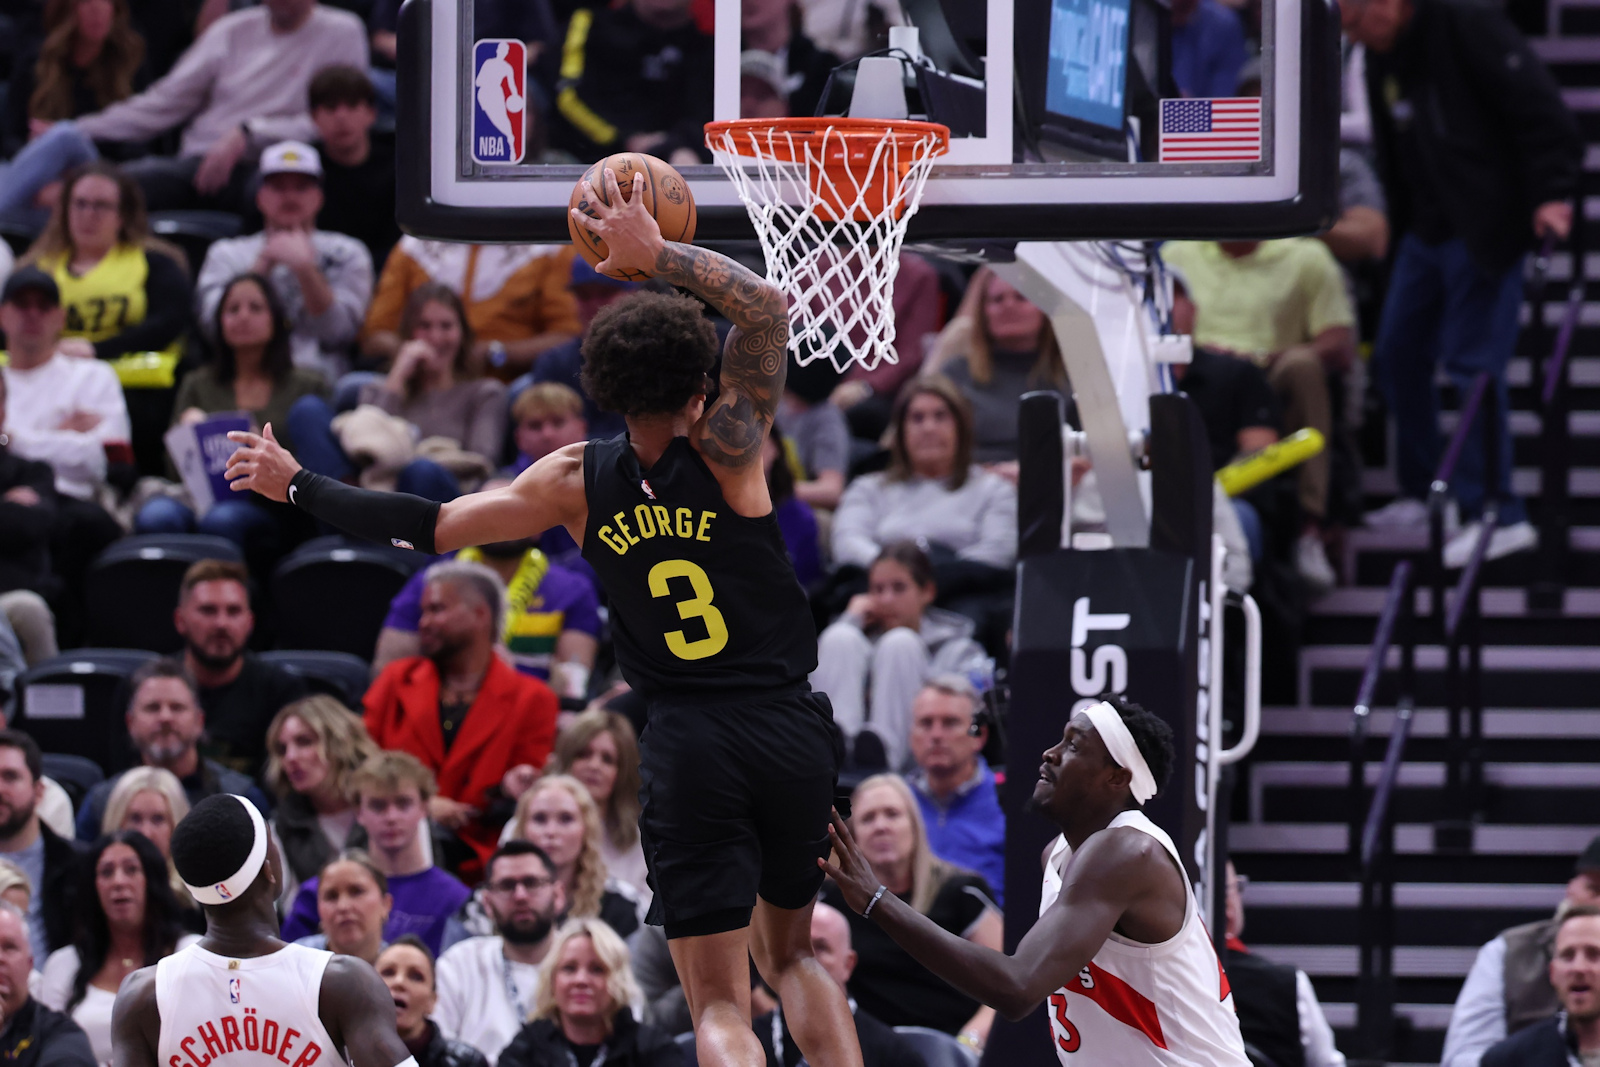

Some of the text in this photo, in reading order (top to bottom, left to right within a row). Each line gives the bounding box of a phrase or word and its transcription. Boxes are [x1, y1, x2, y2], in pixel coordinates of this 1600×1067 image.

[479, 136, 505, 157] NBA
[597, 503, 718, 556] GEORGE
[647, 558, 729, 661] 3
